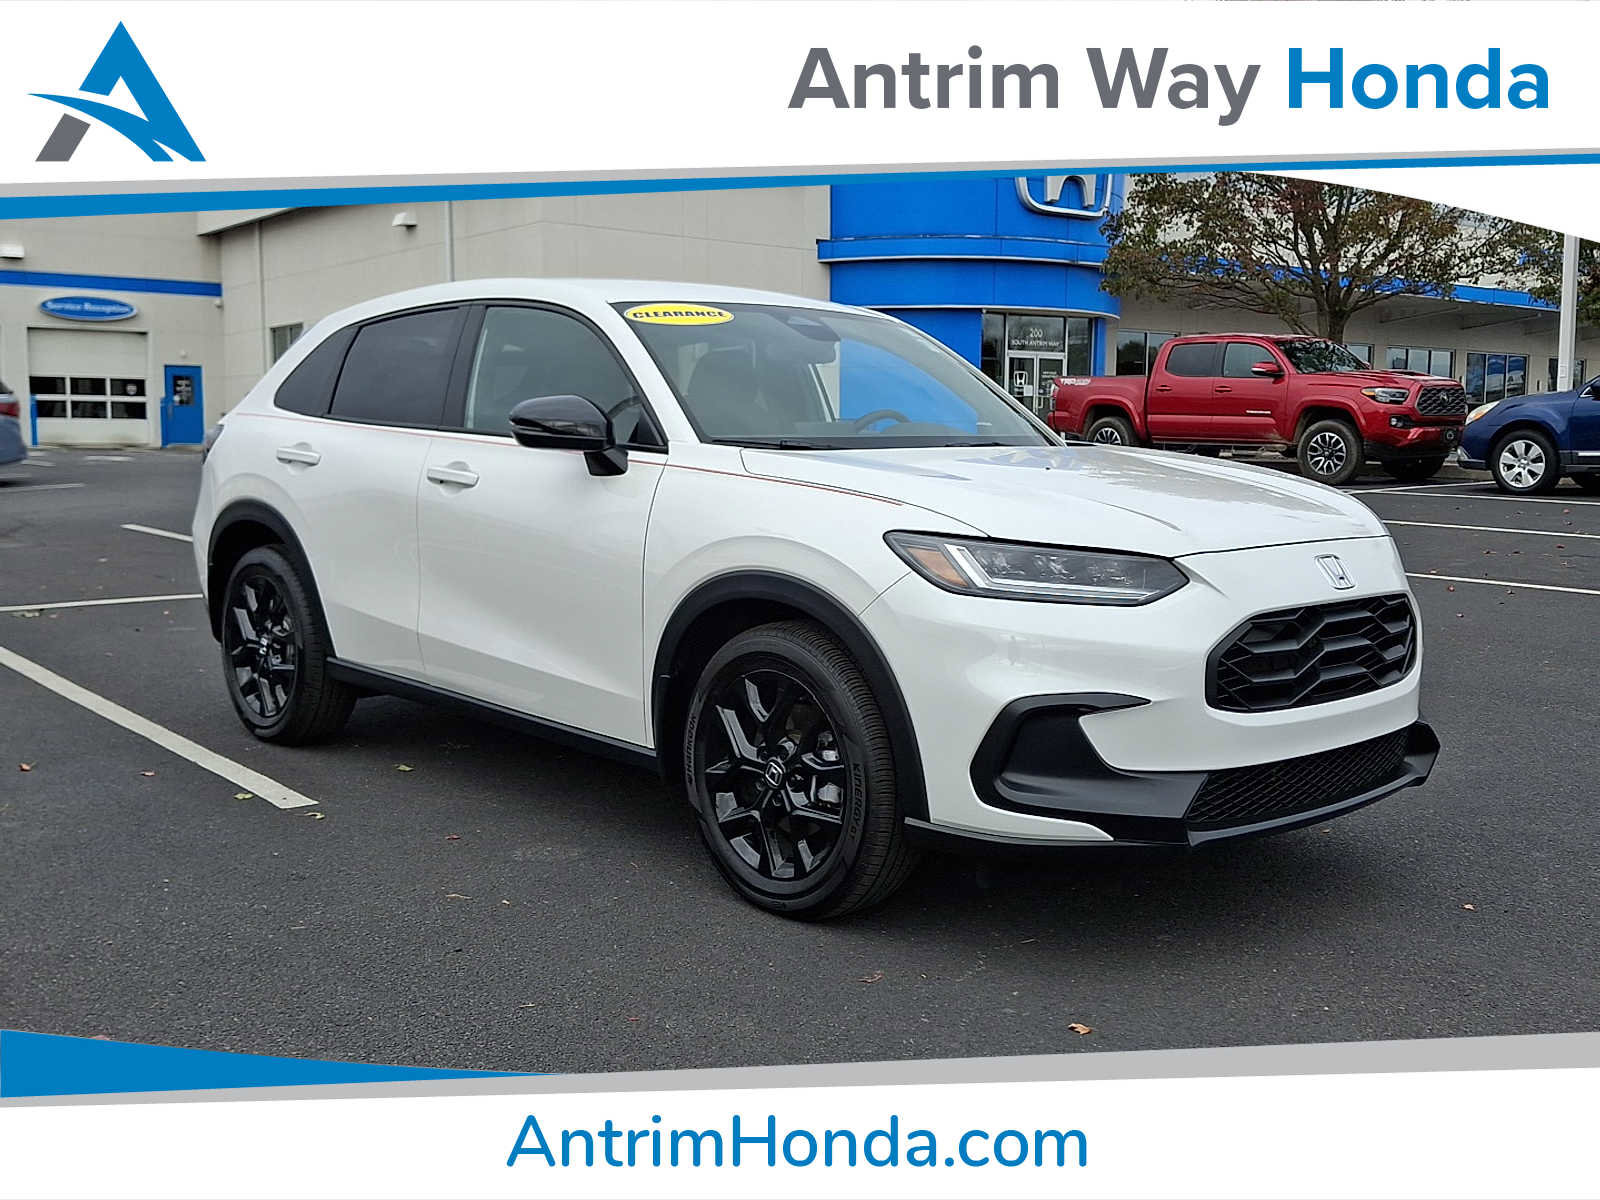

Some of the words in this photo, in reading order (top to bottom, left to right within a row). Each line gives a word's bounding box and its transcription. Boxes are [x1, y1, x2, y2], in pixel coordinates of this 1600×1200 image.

[632, 311, 727, 319] CLEARANCE
[1029, 328, 1043, 338] 200
[852, 763, 865, 825] KINERGY
